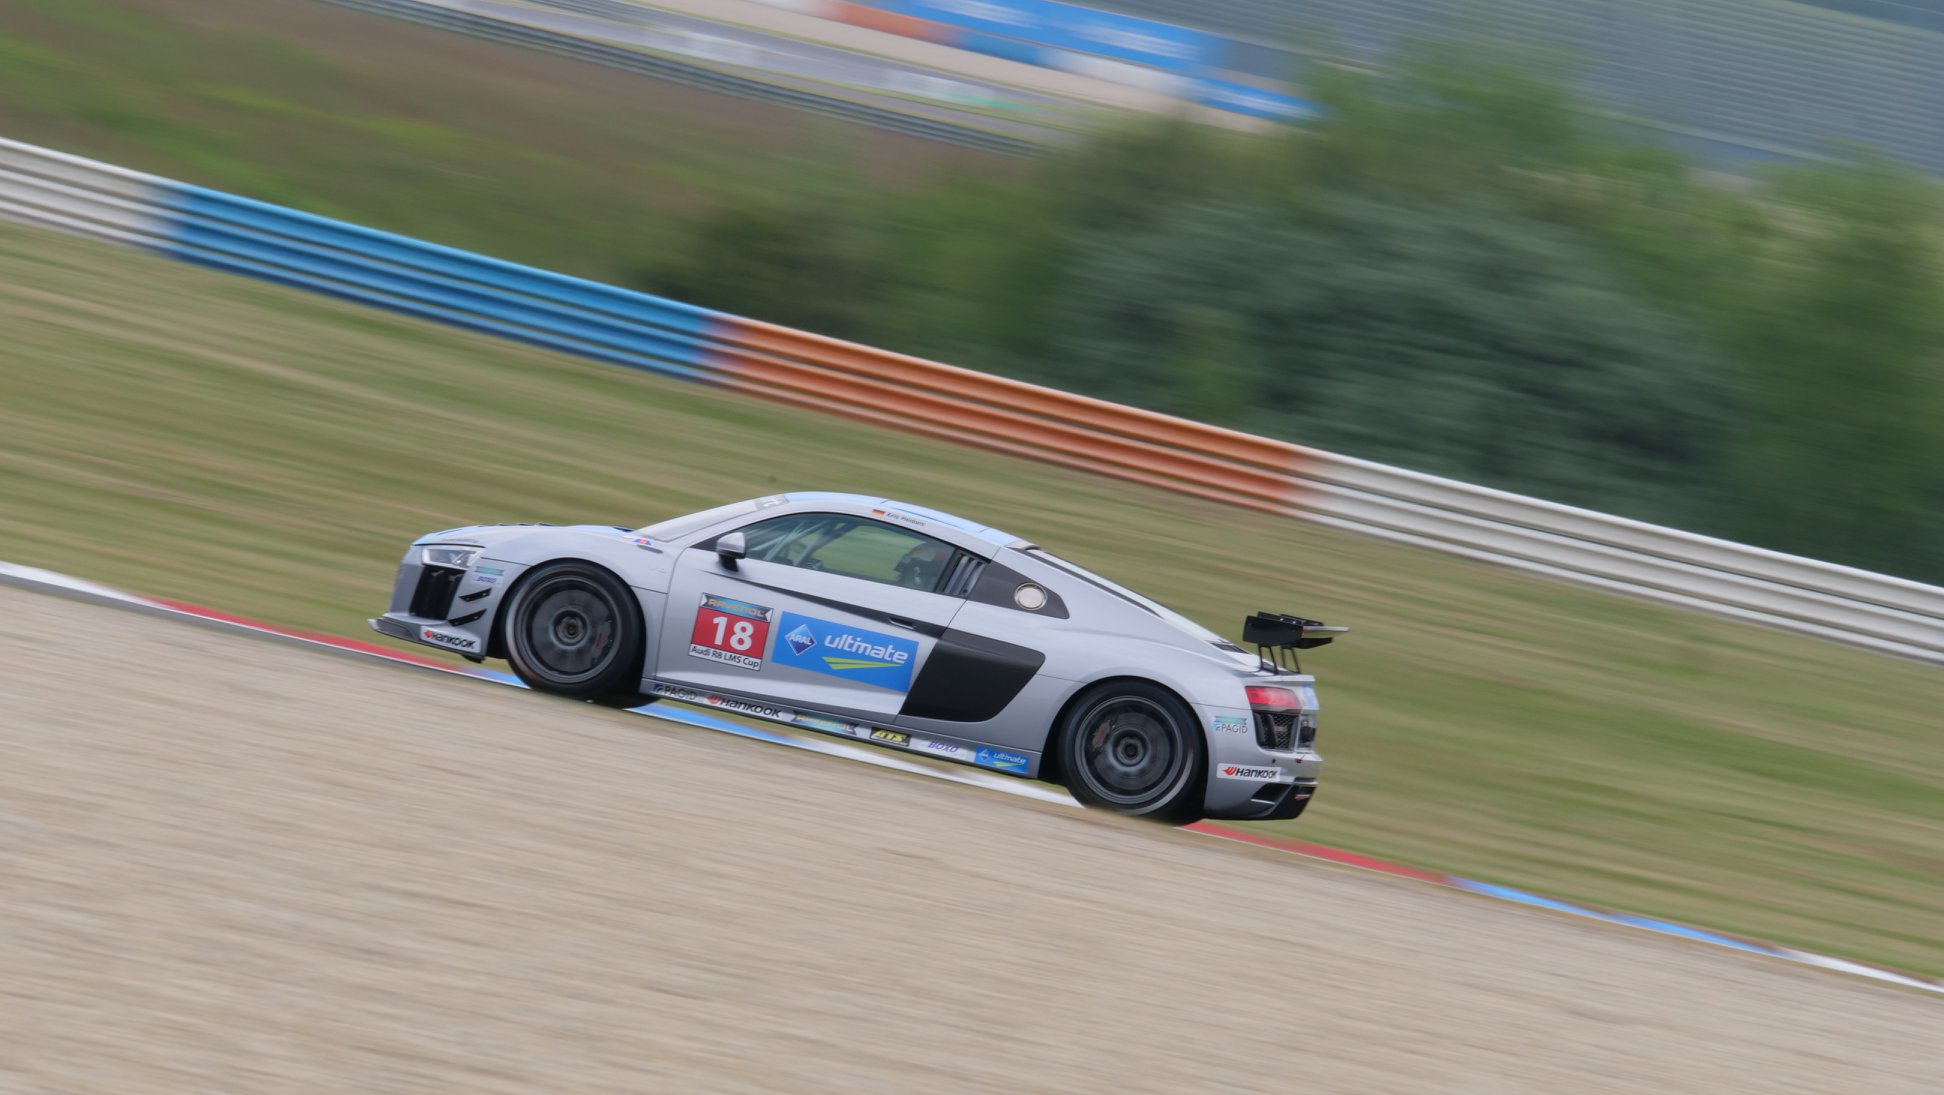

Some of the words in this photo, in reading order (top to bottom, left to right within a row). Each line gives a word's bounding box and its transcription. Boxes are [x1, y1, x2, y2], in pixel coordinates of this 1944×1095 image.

[712, 616, 754, 651] 18
[788, 632, 813, 645] ARAL
[824, 633, 909, 664] ultimate
[691, 646, 710, 656] Audi
[712, 650, 723, 659] R8
[724, 653, 742, 663] LMS
[743, 657, 760, 669] Cup
[664, 685, 698, 701] PAGID
[1221, 724, 1248, 734] PAGID
[994, 752, 1026, 765] ultimate
